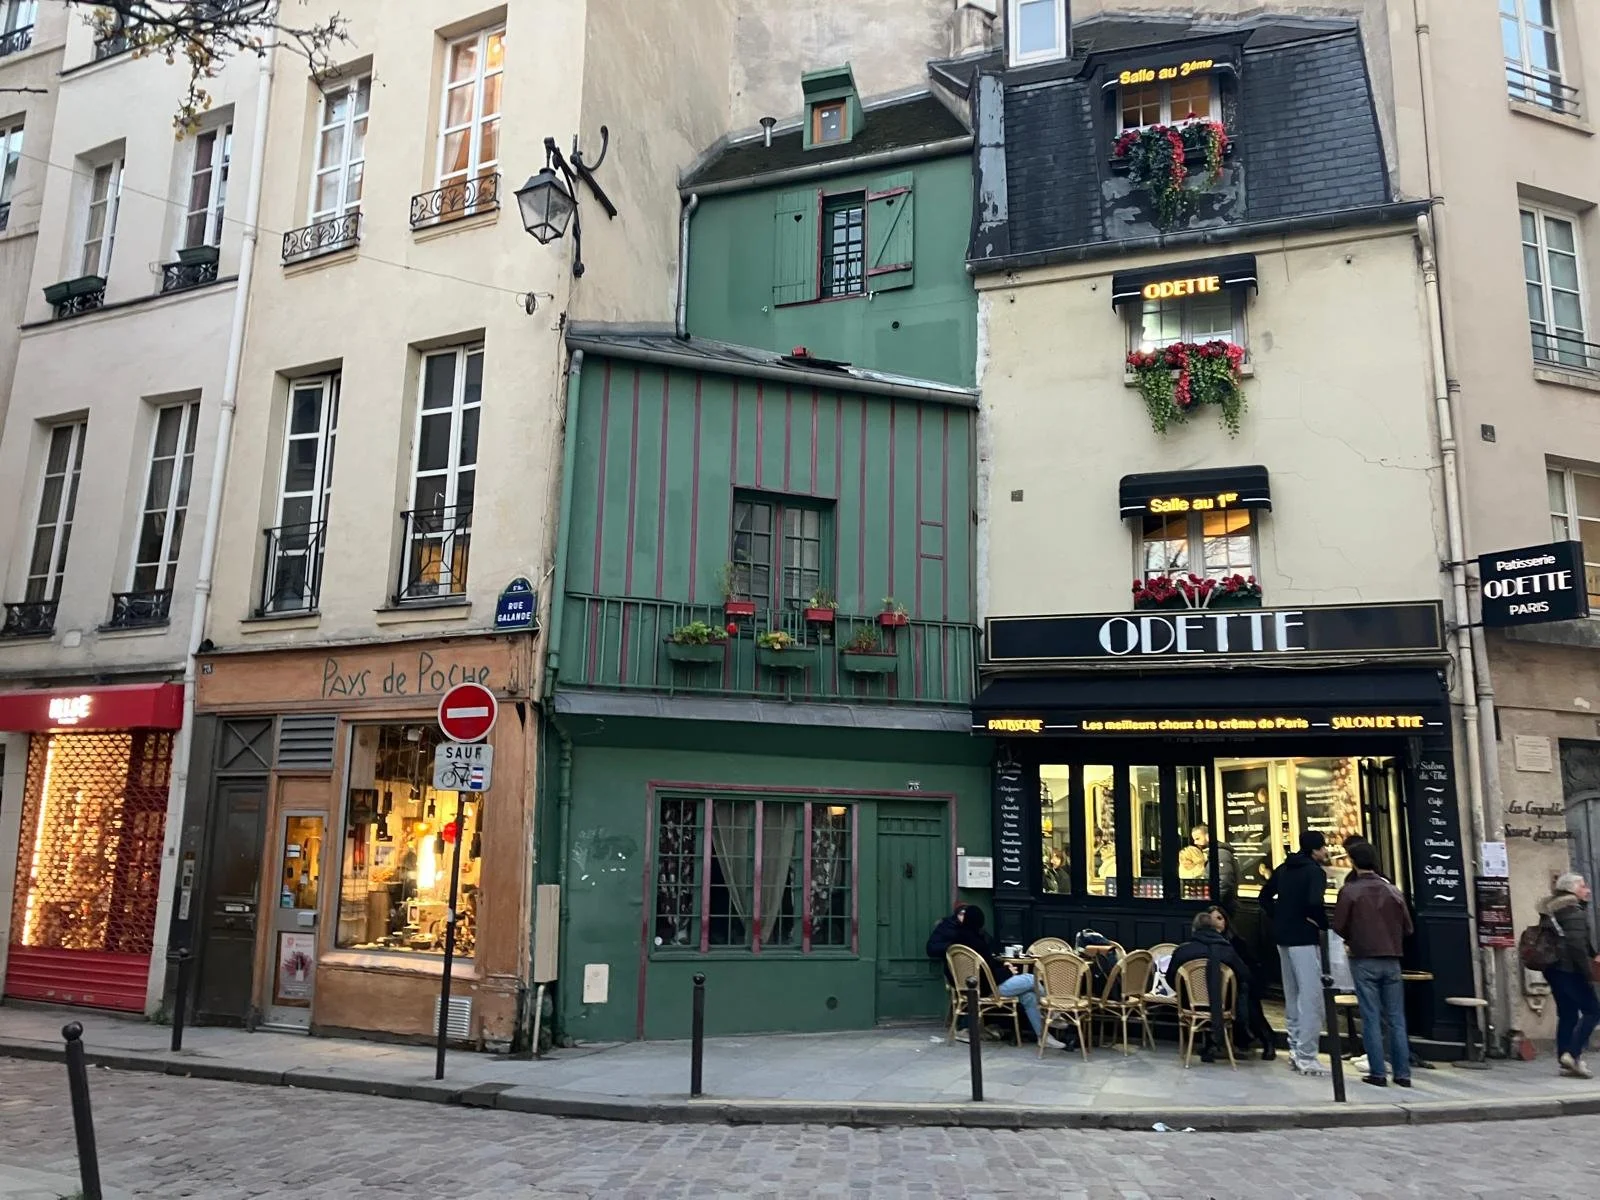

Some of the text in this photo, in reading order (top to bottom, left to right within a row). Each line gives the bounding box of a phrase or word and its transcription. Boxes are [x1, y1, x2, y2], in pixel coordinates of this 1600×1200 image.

[1120, 69, 1155, 85] Salle
[1159, 67, 1177, 79] au
[1143, 276, 1220, 299] ODETTE
[1150, 493, 1238, 513] Salle au 1er
[1496, 554, 1556, 571] Patisserie
[1484, 570, 1573, 599] ODETTE
[508, 601, 524, 610] RUE
[1509, 601, 1550, 616] PARIS
[497, 612, 532, 622] GALANDE
[1099, 611, 1305, 656] ODETTE
[383, 662, 407, 695] de
[1082, 720, 1103, 730] Les
[1104, 719, 1157, 730] meilleurs
[1158, 719, 1193, 730] choux
[1205, 719, 1217, 729] la
[1258, 718, 1274, 729] de
[1275, 718, 1309, 729] Paris
[1332, 716, 1375, 730] SALON
[1376, 716, 1395, 728] DE
[446, 747, 482, 759] SAUF
[1419, 761, 1445, 770] Salon
[1419, 771, 1429, 780] de
[1424, 839, 1455, 847] Chocolat
[1424, 864, 1446, 875] Salle
[1436, 876, 1459, 888] étage
